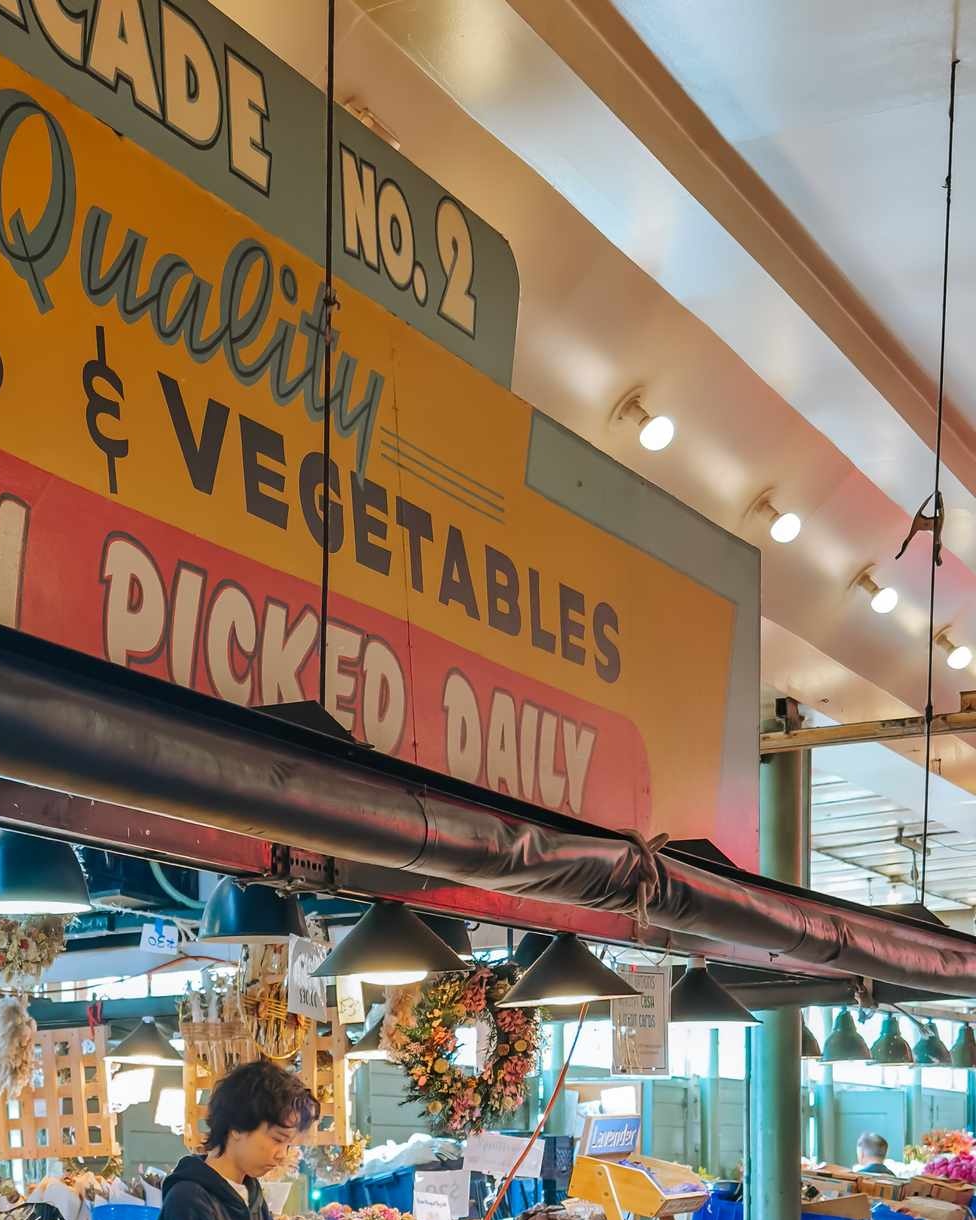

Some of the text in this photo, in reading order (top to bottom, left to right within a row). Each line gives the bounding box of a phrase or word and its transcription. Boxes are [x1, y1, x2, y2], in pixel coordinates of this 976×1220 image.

[339, 141, 429, 308] NO.
[435, 196, 478, 340] 2
[82, 325, 130, 496] &
[157, 370, 621, 684] VEGETABLES
[98, 530, 406, 757] PICKED
[442, 667, 598, 815] DAILY
[591, 1122, 637, 1149] Lavender
